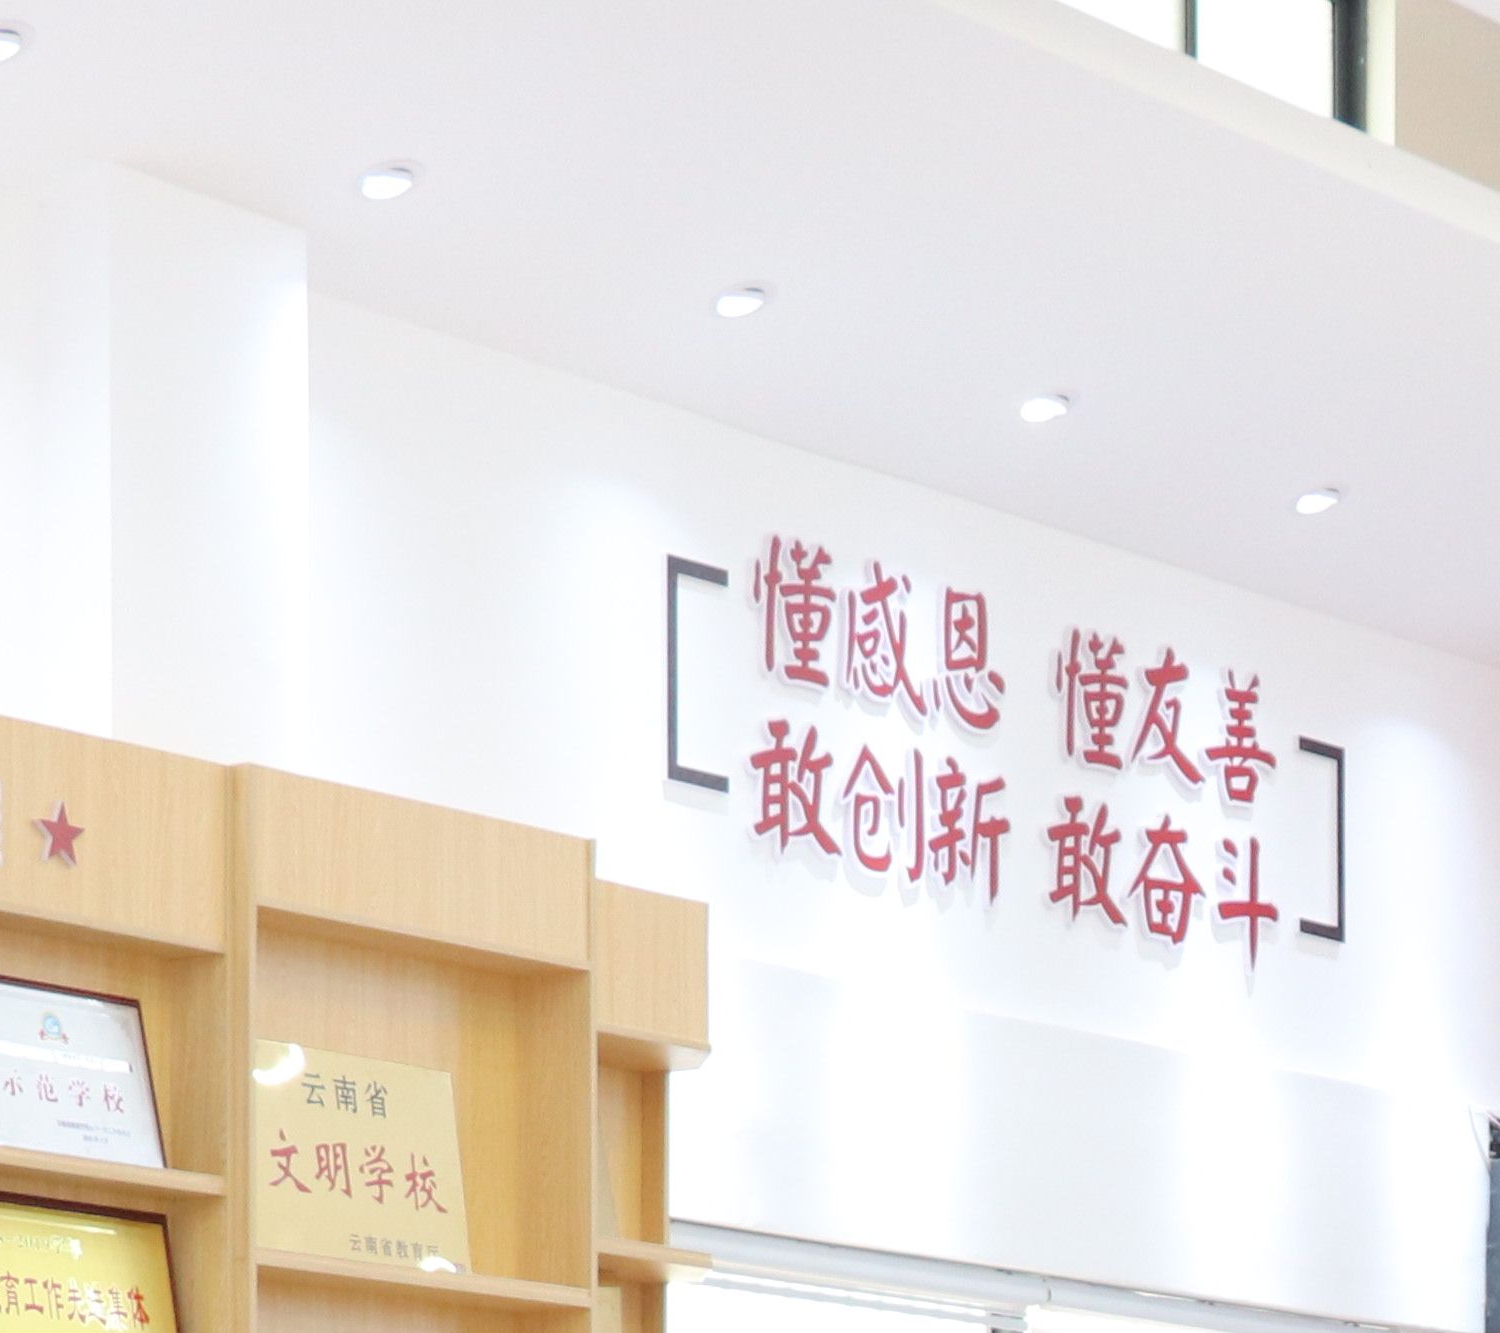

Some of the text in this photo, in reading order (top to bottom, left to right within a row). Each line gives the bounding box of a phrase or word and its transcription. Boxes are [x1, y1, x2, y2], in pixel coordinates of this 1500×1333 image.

[753, 536, 1276, 803] 懂感恩 懂友善
[750, 721, 1278, 969] 敢创新 敢奋斗
[3, 1069, 125, 1114] 示范学校
[302, 1073, 387, 1118] 云南省
[269, 1129, 448, 1214] 文明学校
